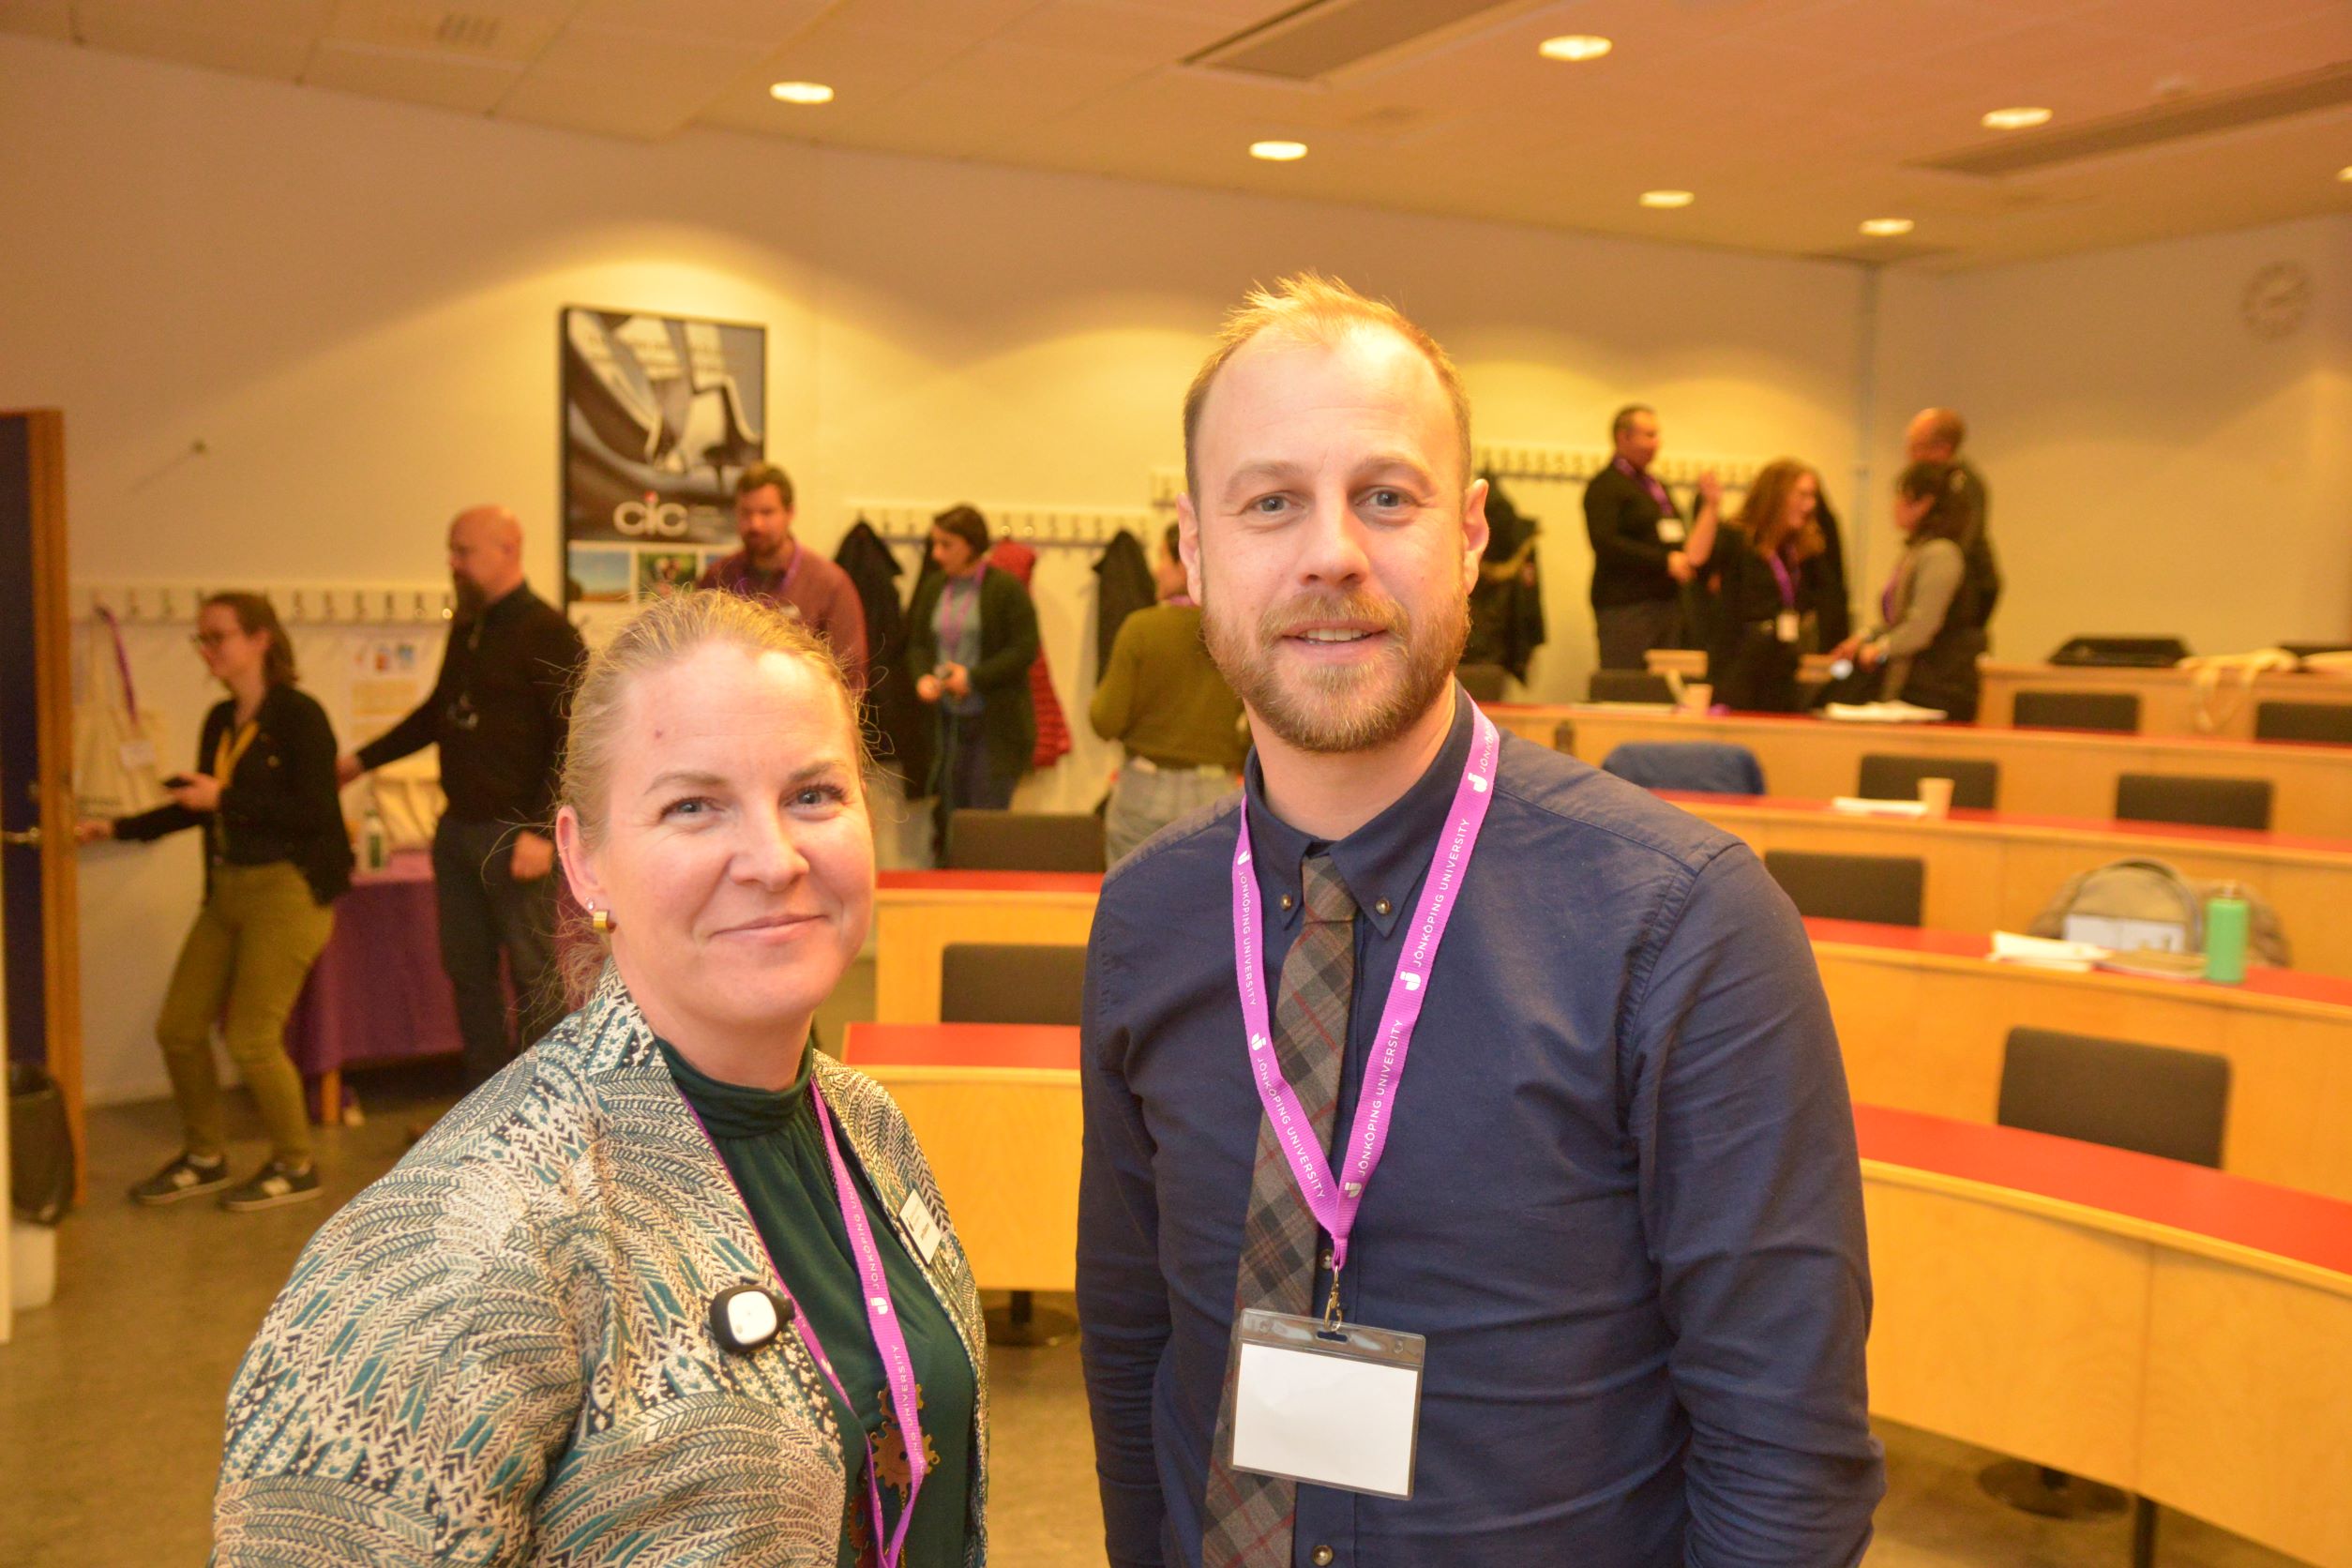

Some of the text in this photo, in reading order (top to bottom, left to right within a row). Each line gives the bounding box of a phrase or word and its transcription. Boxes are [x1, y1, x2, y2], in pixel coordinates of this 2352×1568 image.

[1440, 818, 1470, 891] UNIVERSITY
[1243, 938, 1257, 1006] UNIVERSITY
[1375, 1019, 1403, 1095] UNIVERSITY
[1286, 1127, 1326, 1199] UNIVERSITY
[891, 1344, 914, 1426] UNIVERSITY
